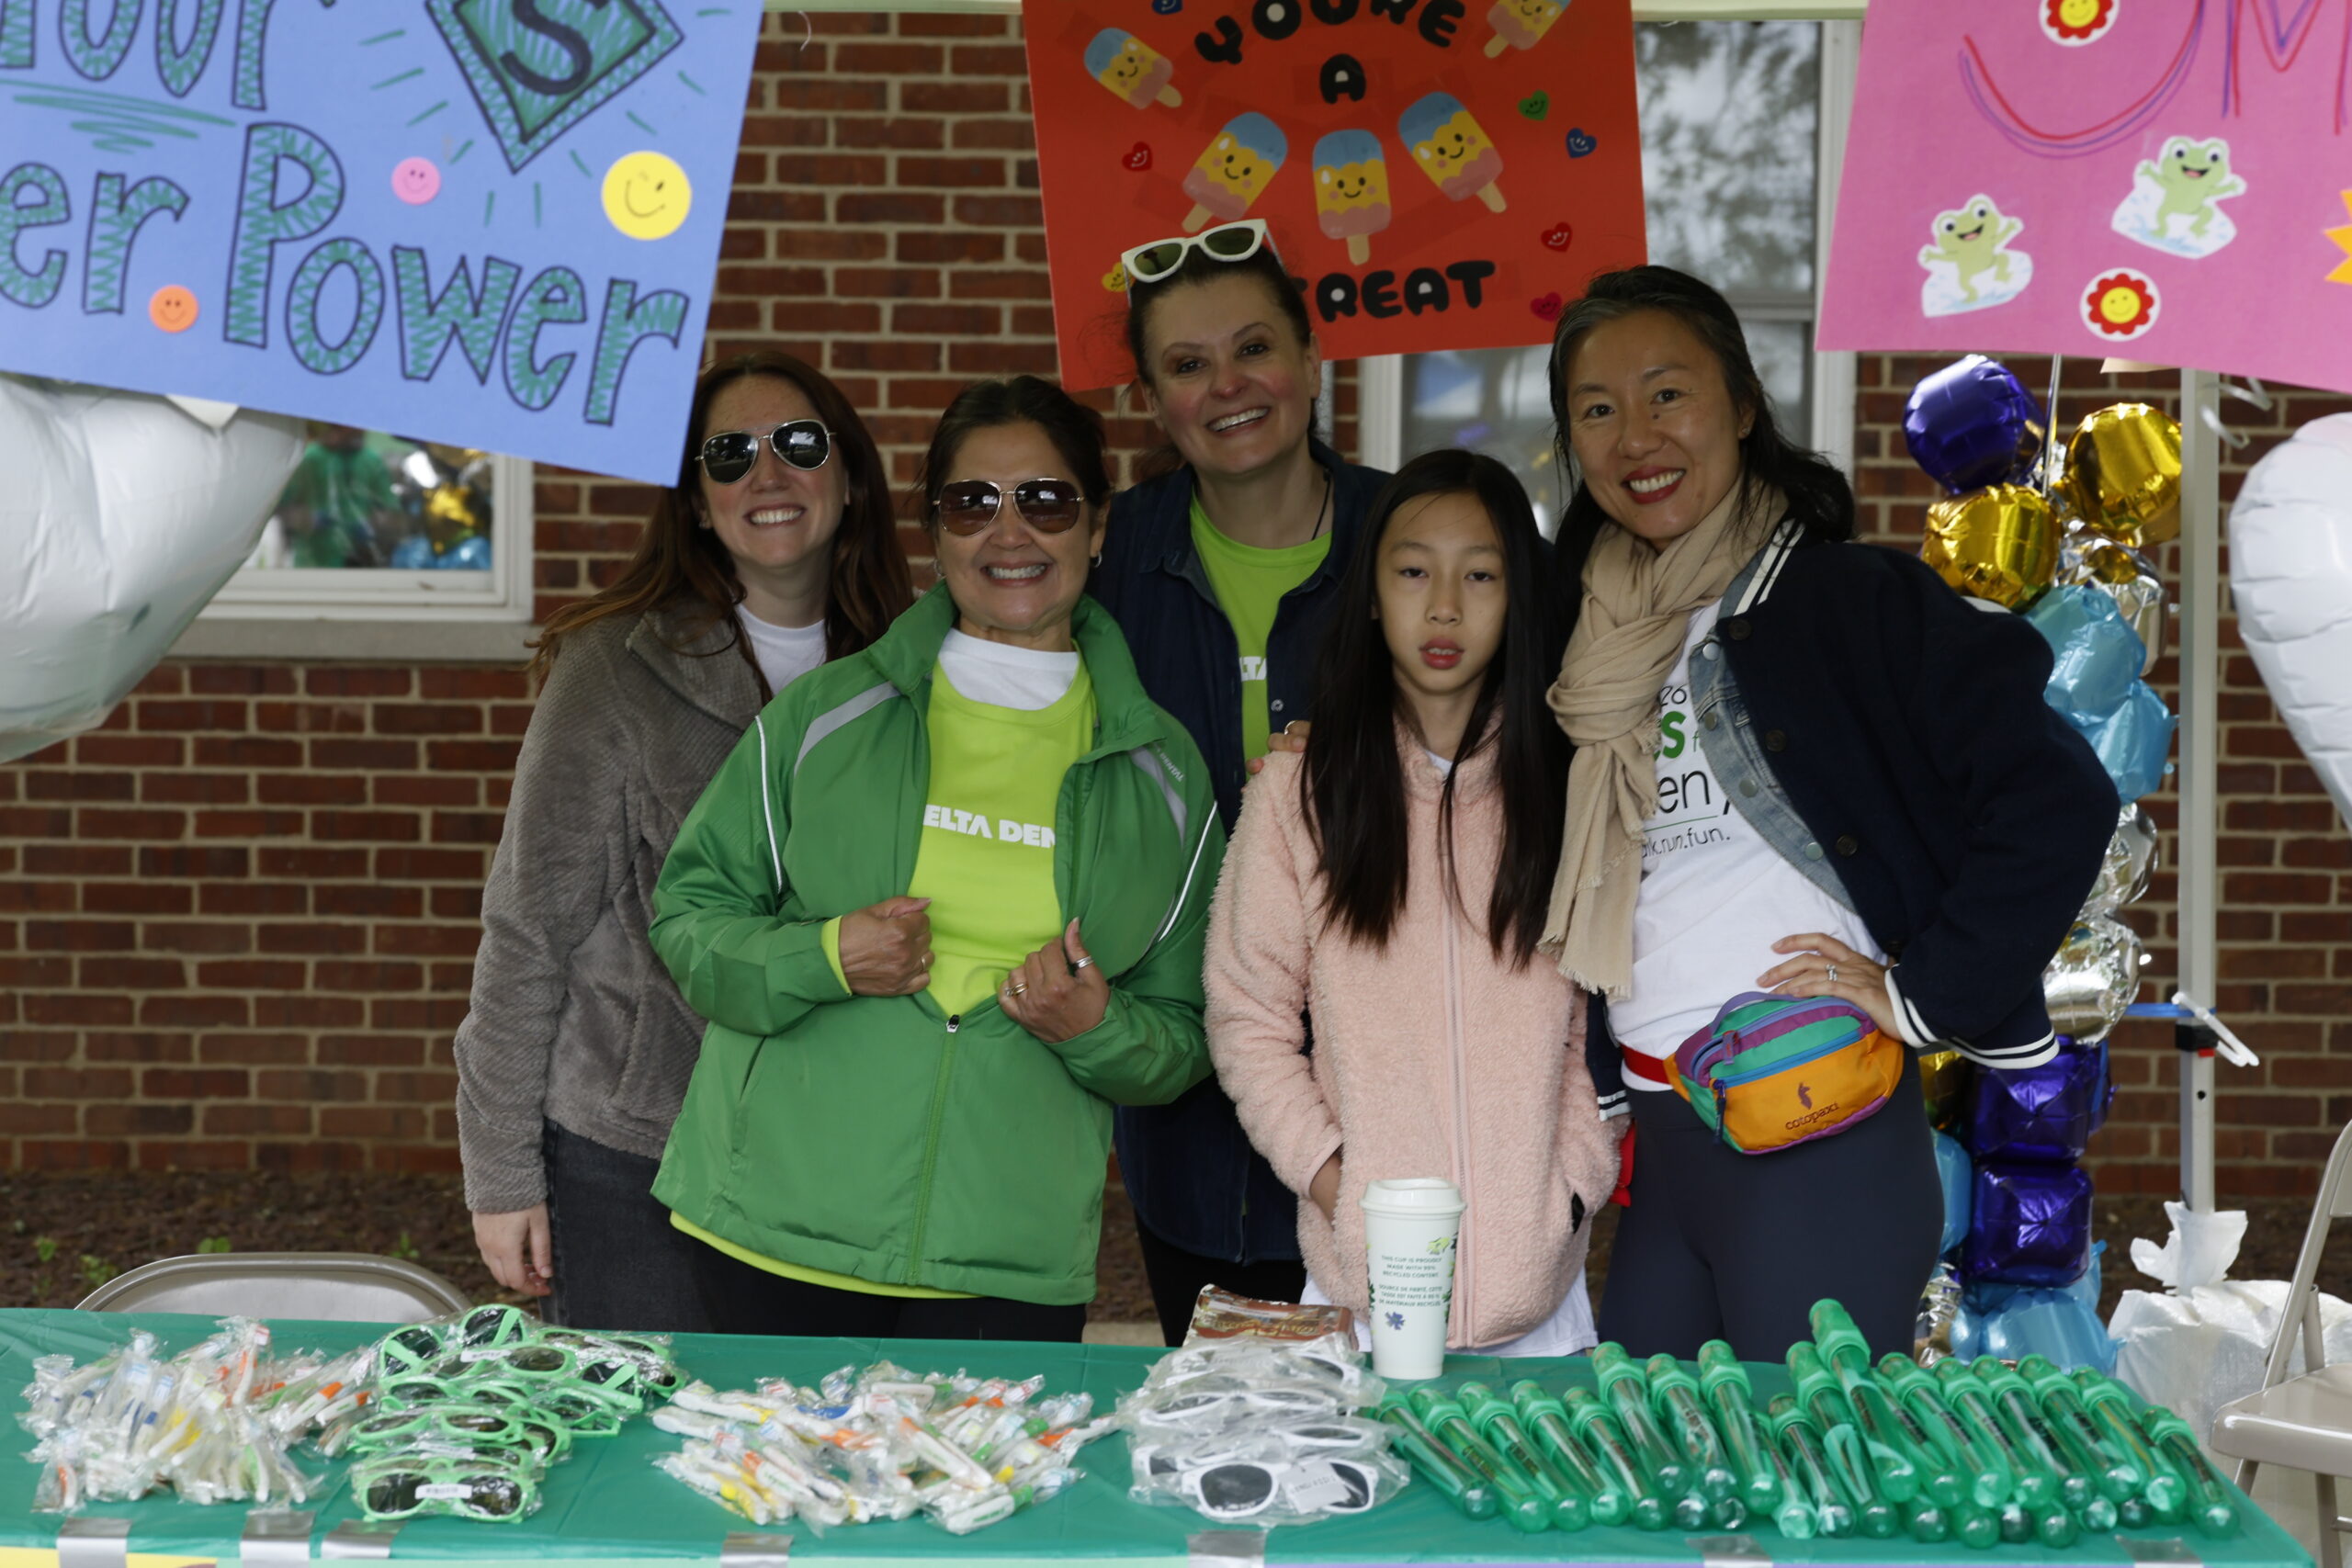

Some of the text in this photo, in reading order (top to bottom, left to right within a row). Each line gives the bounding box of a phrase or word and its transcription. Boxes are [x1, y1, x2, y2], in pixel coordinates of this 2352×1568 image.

[1319, 53, 1366, 104] A
[223, 121, 690, 426] Power
[1290, 260, 1496, 322] REAT
[1656, 711, 1687, 761] S
[1785, 1101, 1840, 1131] cotopaxi
